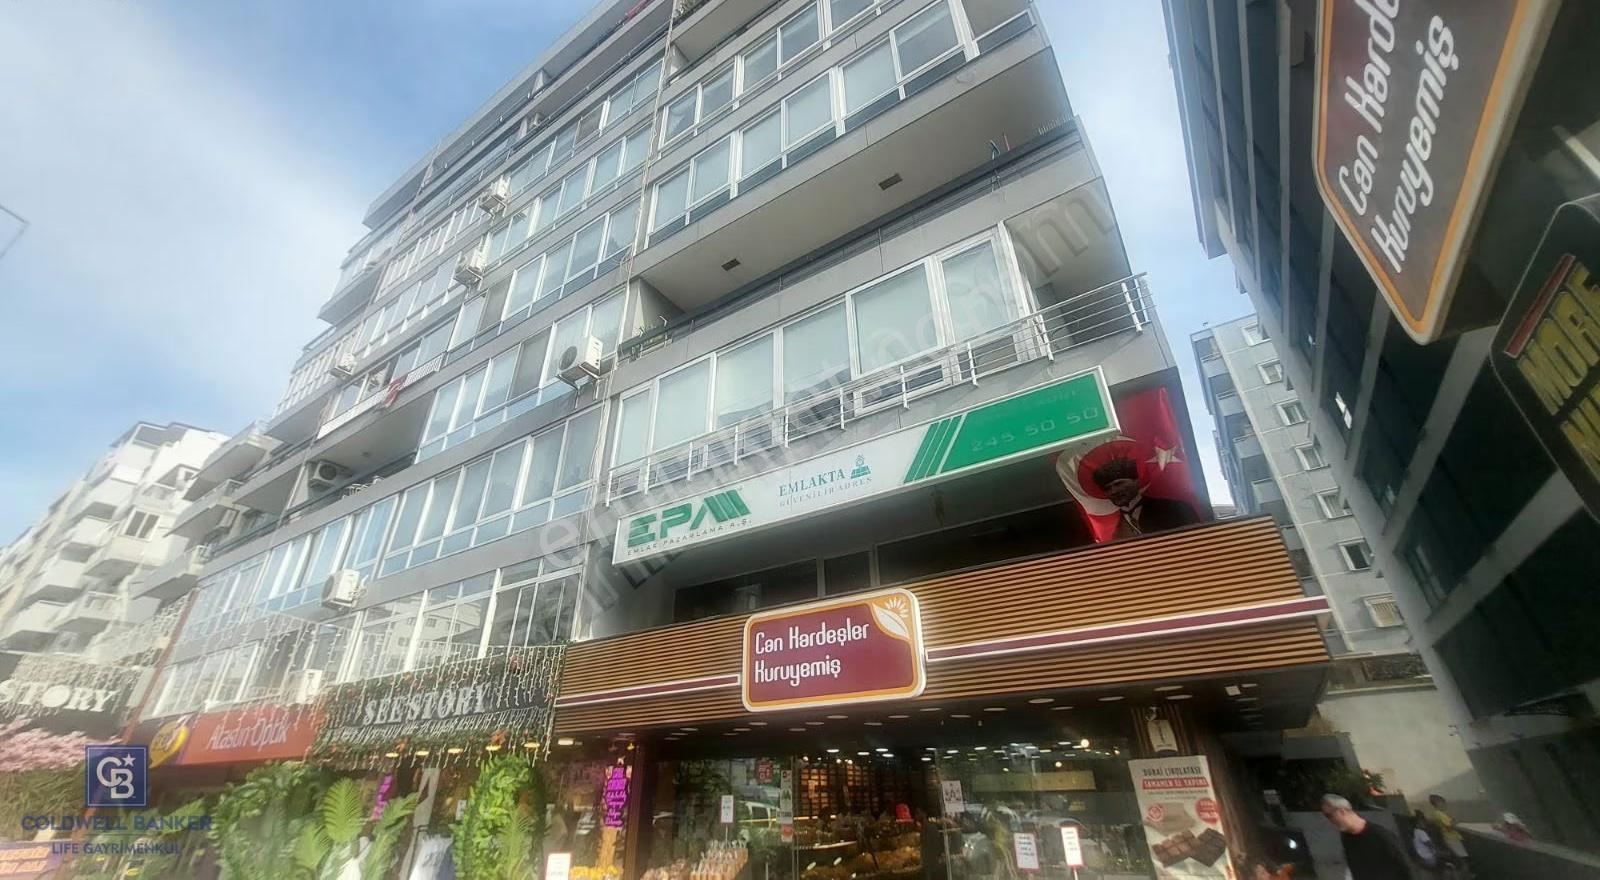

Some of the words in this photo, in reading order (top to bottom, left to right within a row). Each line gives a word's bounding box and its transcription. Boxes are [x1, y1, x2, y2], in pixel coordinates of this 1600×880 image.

[1370, 14, 1459, 274] Kuruyemiş
[1338, 134, 1379, 217] Can
[778, 467, 846, 497] EMLAKTA
[755, 631, 784, 655] Can
[788, 617, 870, 650] Kardeşler
[754, 654, 842, 687] Kuruyemiş
